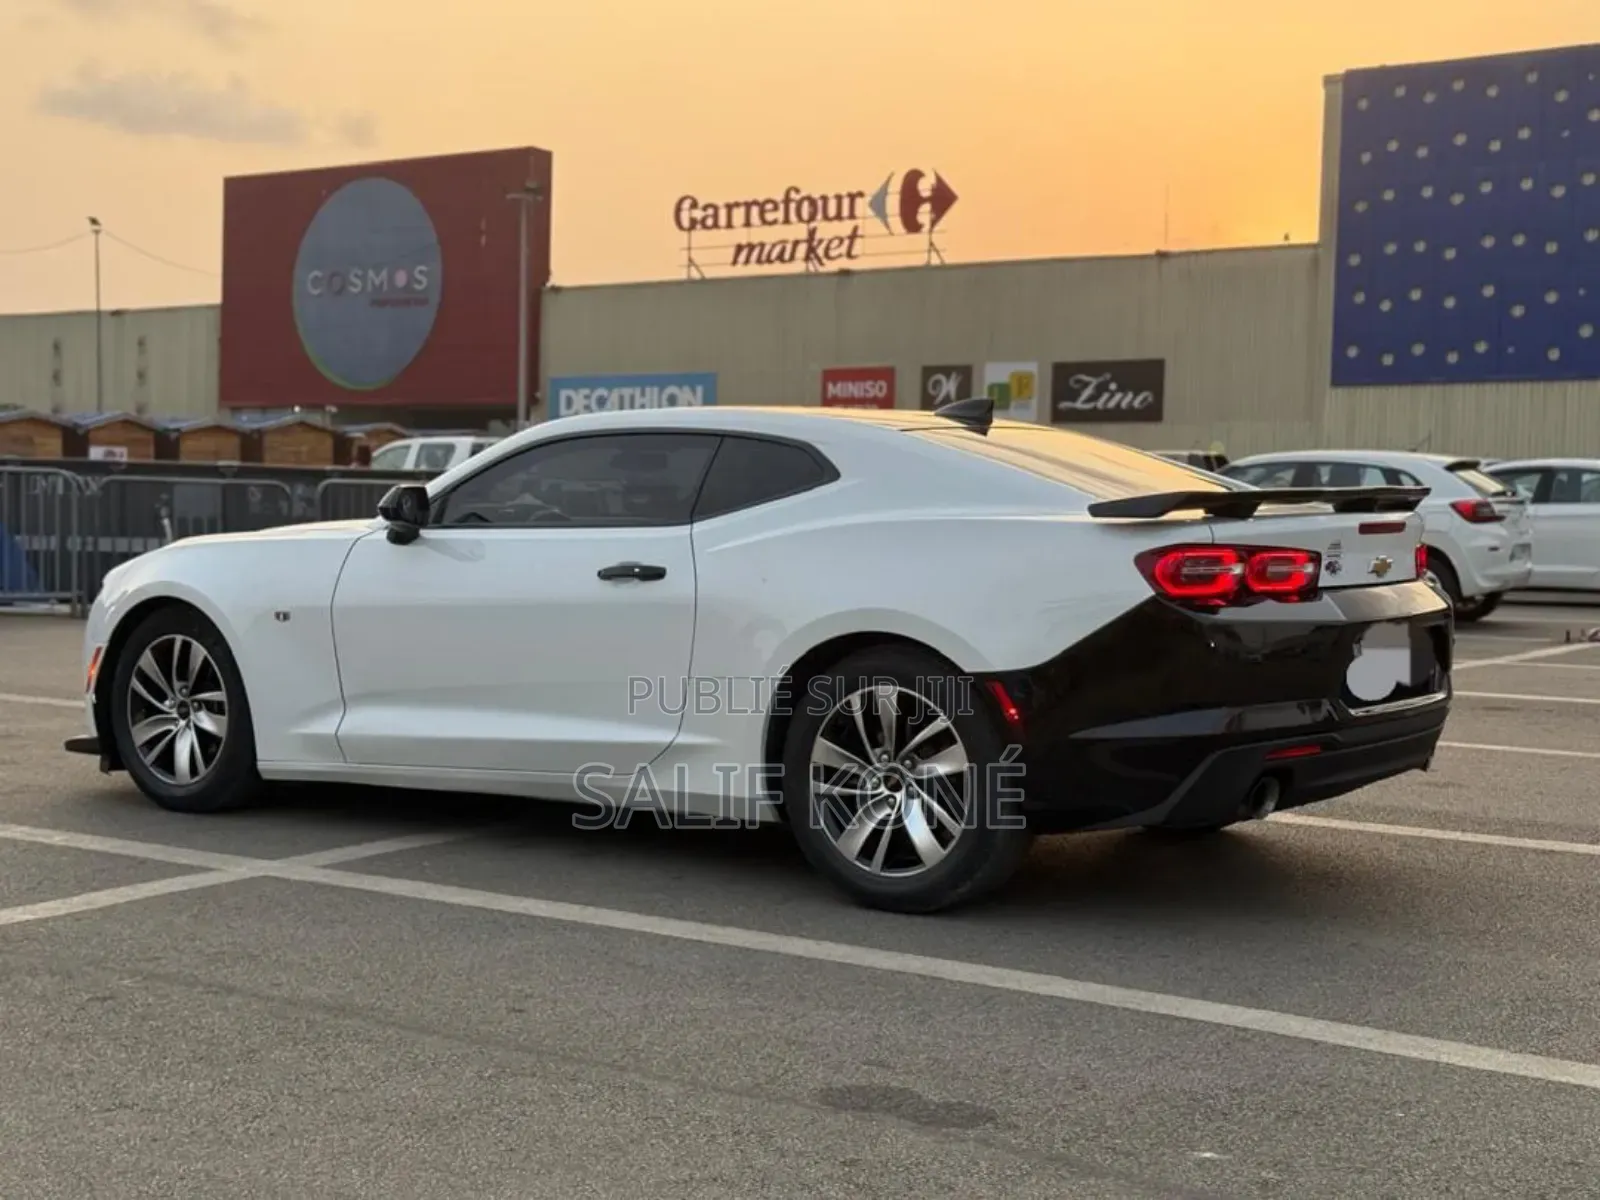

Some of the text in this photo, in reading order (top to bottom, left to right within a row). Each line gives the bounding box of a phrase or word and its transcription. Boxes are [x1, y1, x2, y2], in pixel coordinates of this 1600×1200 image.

[674, 186, 865, 232] Carrefour
[732, 225, 865, 267] market
[306, 265, 429, 296] COSMOS
[826, 380, 888, 399] MINISO
[1057, 373, 1154, 410] Zino
